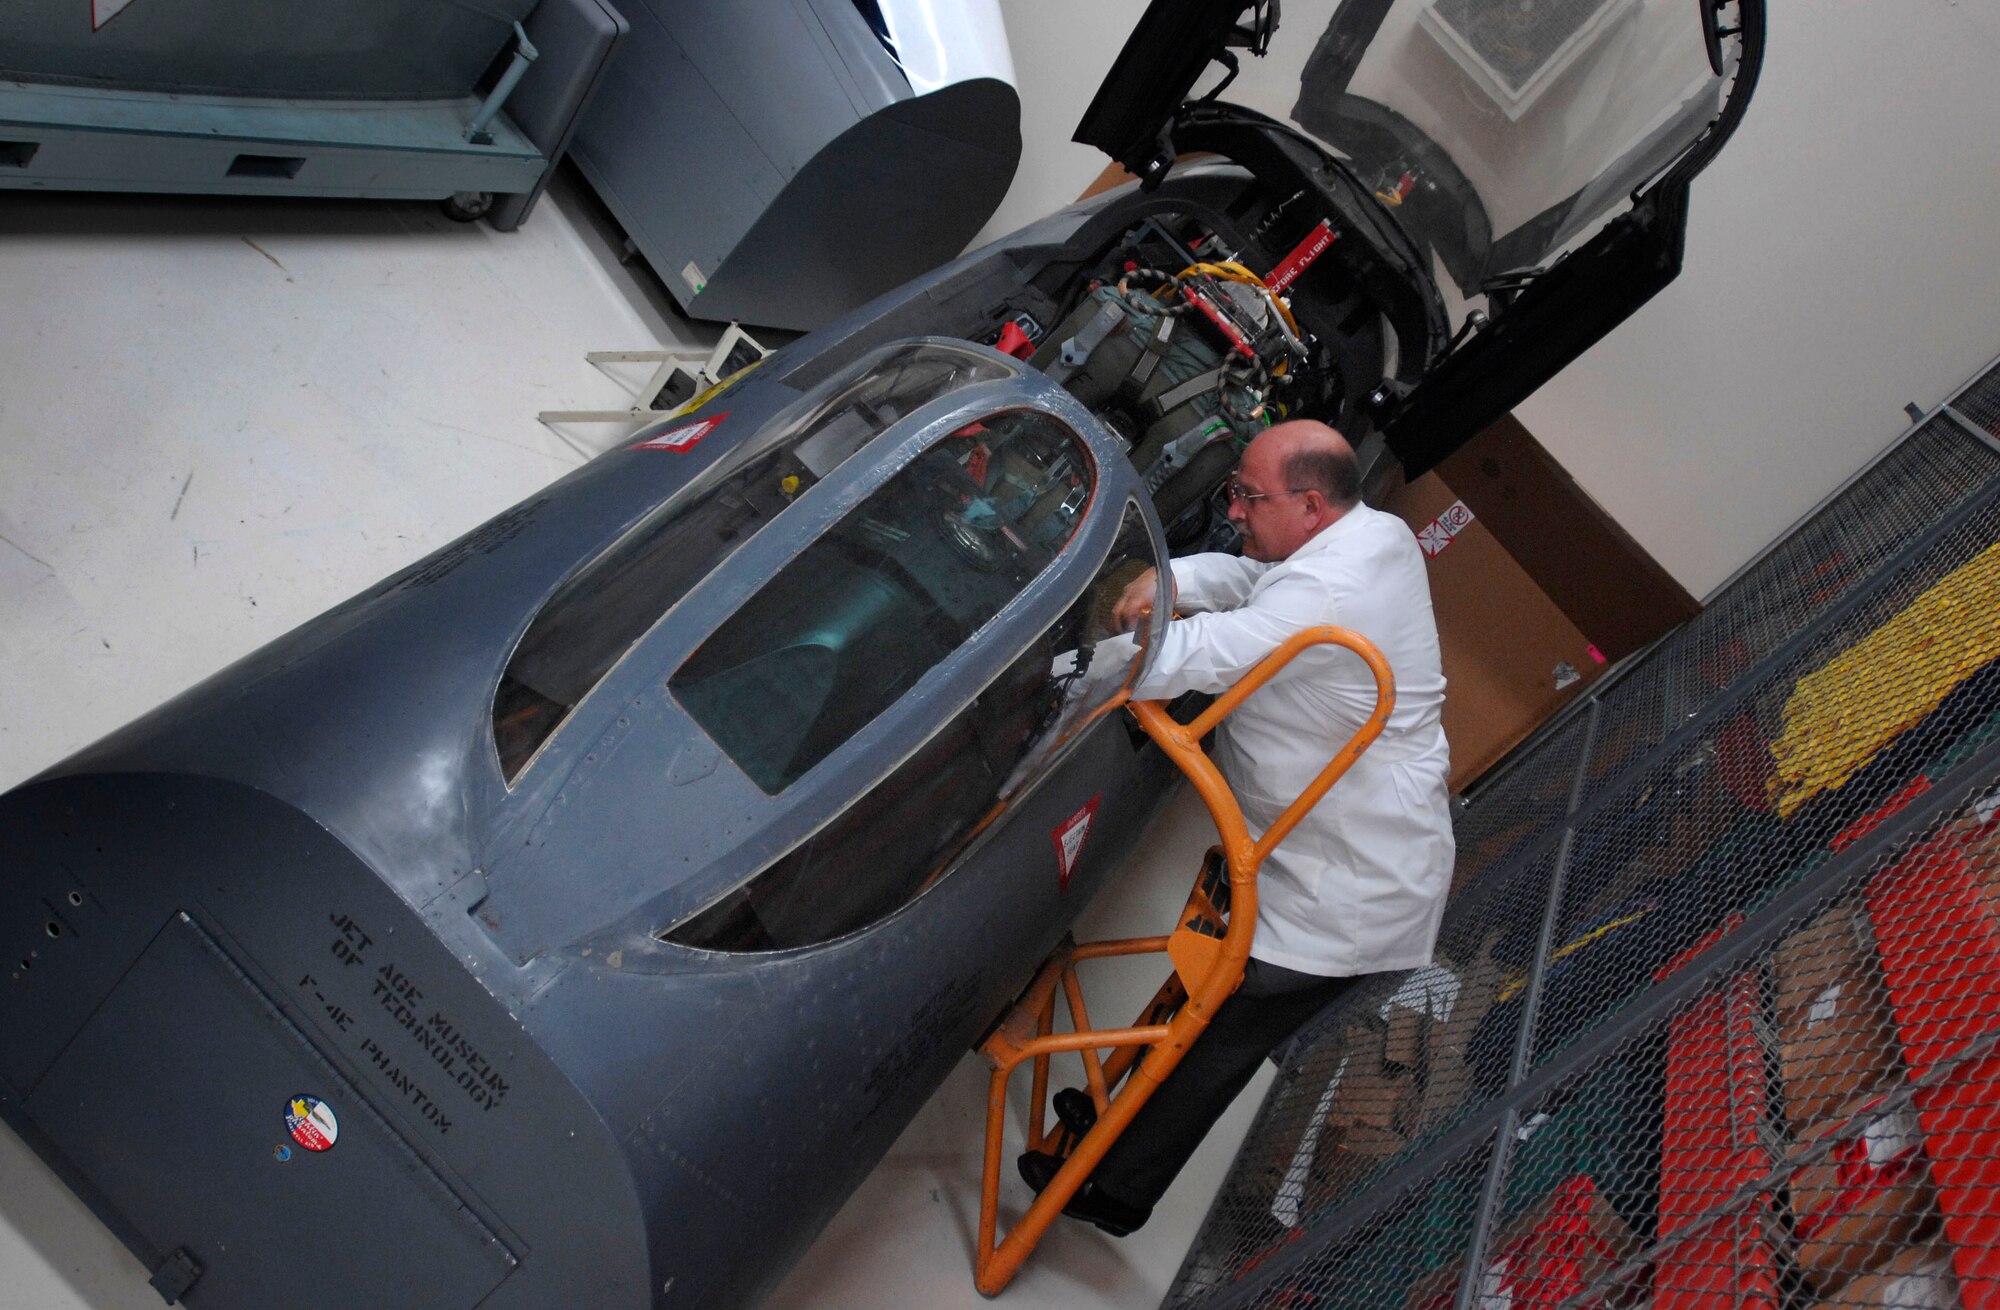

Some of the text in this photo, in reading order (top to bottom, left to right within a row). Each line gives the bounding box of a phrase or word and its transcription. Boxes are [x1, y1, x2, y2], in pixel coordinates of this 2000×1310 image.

[1270, 235, 1329, 293] EFORE FLIGHT
[1424, 528, 1443, 549] FRAGILE
[299, 974, 452, 1134] F-4E PHANTOM
[329, 912, 510, 1098] JET AGE MUSEUM
[331, 939, 500, 1112] OF TECHNOLOGY
